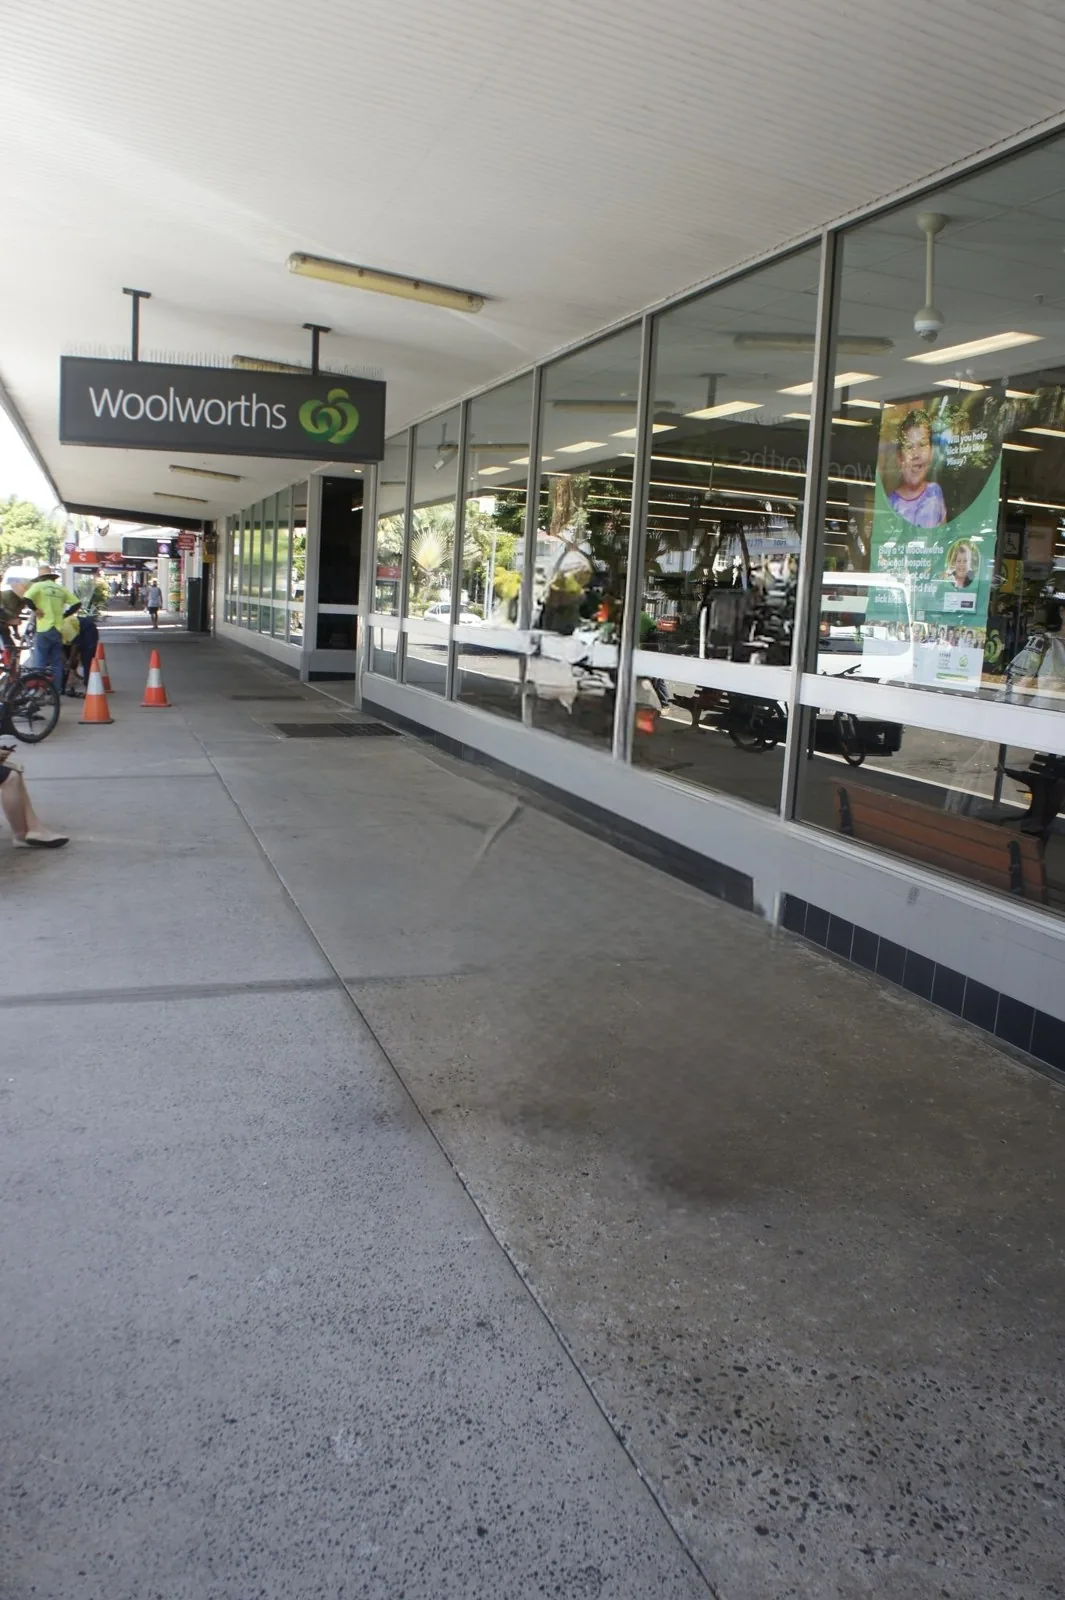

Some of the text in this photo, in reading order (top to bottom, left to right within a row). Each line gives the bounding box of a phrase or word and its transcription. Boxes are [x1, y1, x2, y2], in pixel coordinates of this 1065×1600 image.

[88, 386, 287, 429] Woolworths
[960, 434, 972, 446] you
[972, 430, 988, 442] help
